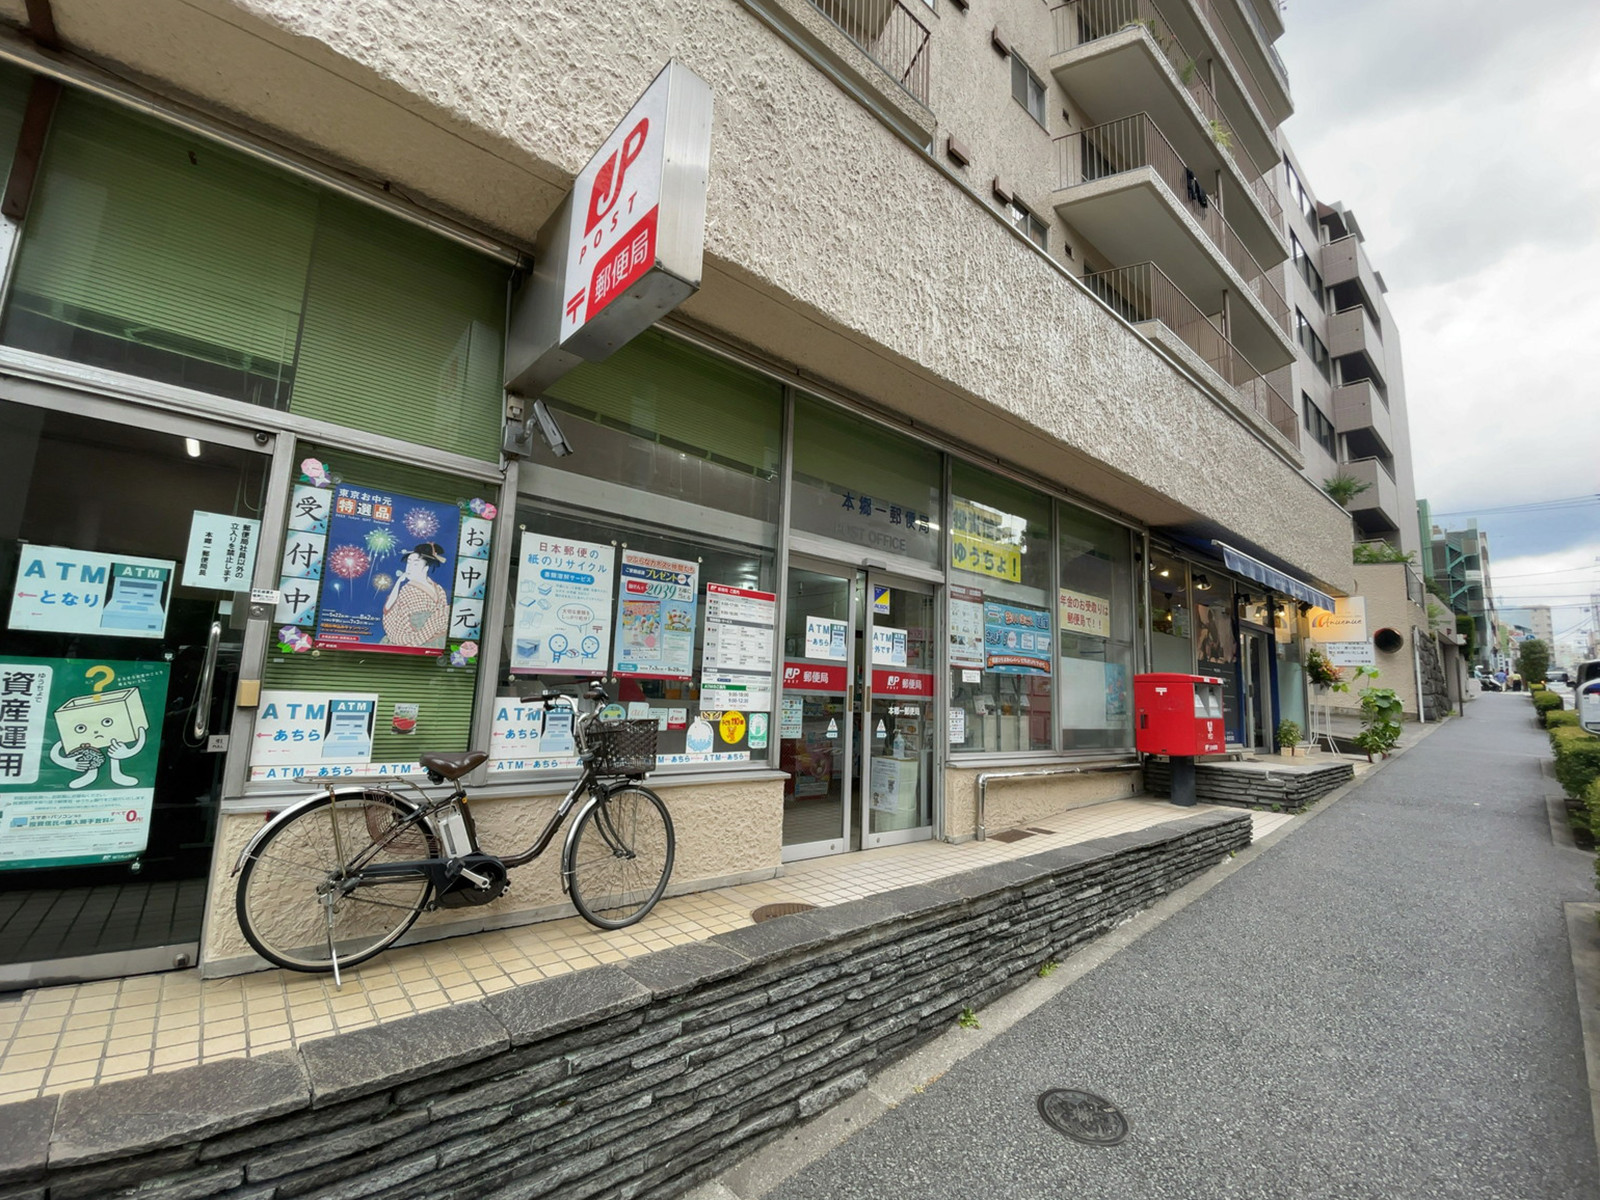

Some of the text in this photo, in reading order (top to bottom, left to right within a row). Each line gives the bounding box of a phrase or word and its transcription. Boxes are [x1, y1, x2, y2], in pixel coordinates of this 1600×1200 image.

[579, 191, 637, 265] POST
[594, 228, 649, 304] 郵便局
[338, 488, 393, 506] 東京お中元
[337, 499, 391, 520] 特選品
[841, 491, 930, 535] 本郷一郵便局
[868, 529, 906, 551] OFFICE
[198, 531, 213, 577] 本郷一郵便局長
[222, 522, 239, 582] 立入りを禁止します
[234, 524, 252, 579] 郵便局社員以外の
[283, 494, 323, 616] 受付中
[539, 541, 599, 560] 日本郵便の
[953, 542, 1017, 577] ゆうちょ!
[24, 558, 106, 585] ATM
[527, 553, 608, 573] 紙のリサイクル
[121, 566, 161, 580] ATM
[453, 527, 486, 629] お中元
[39, 589, 99, 608] となり
[645, 583, 677, 600] 2039
[1060, 594, 1109, 616] 年金のお受取りは
[807, 623, 830, 635] ATM
[873, 632, 892, 643] ATM
[812, 638, 829, 647] あちら
[874, 645, 891, 654] 外です
[803, 671, 829, 684] 郵便局
[902, 678, 923, 690] 郵便局
[261, 703, 325, 721] ATM
[337, 702, 370, 712] ATM
[496, 706, 541, 722] ATM
[0, 671, 36, 778] 資産運用
[273, 729, 321, 743] あちら
[505, 728, 539, 741] あちら
[496, 759, 560, 770] ATM あちら
[671, 755, 691, 763] あちら
[727, 753, 745, 761] あちら
[266, 765, 354, 779] ATM あちら
[379, 764, 413, 774] ATM
